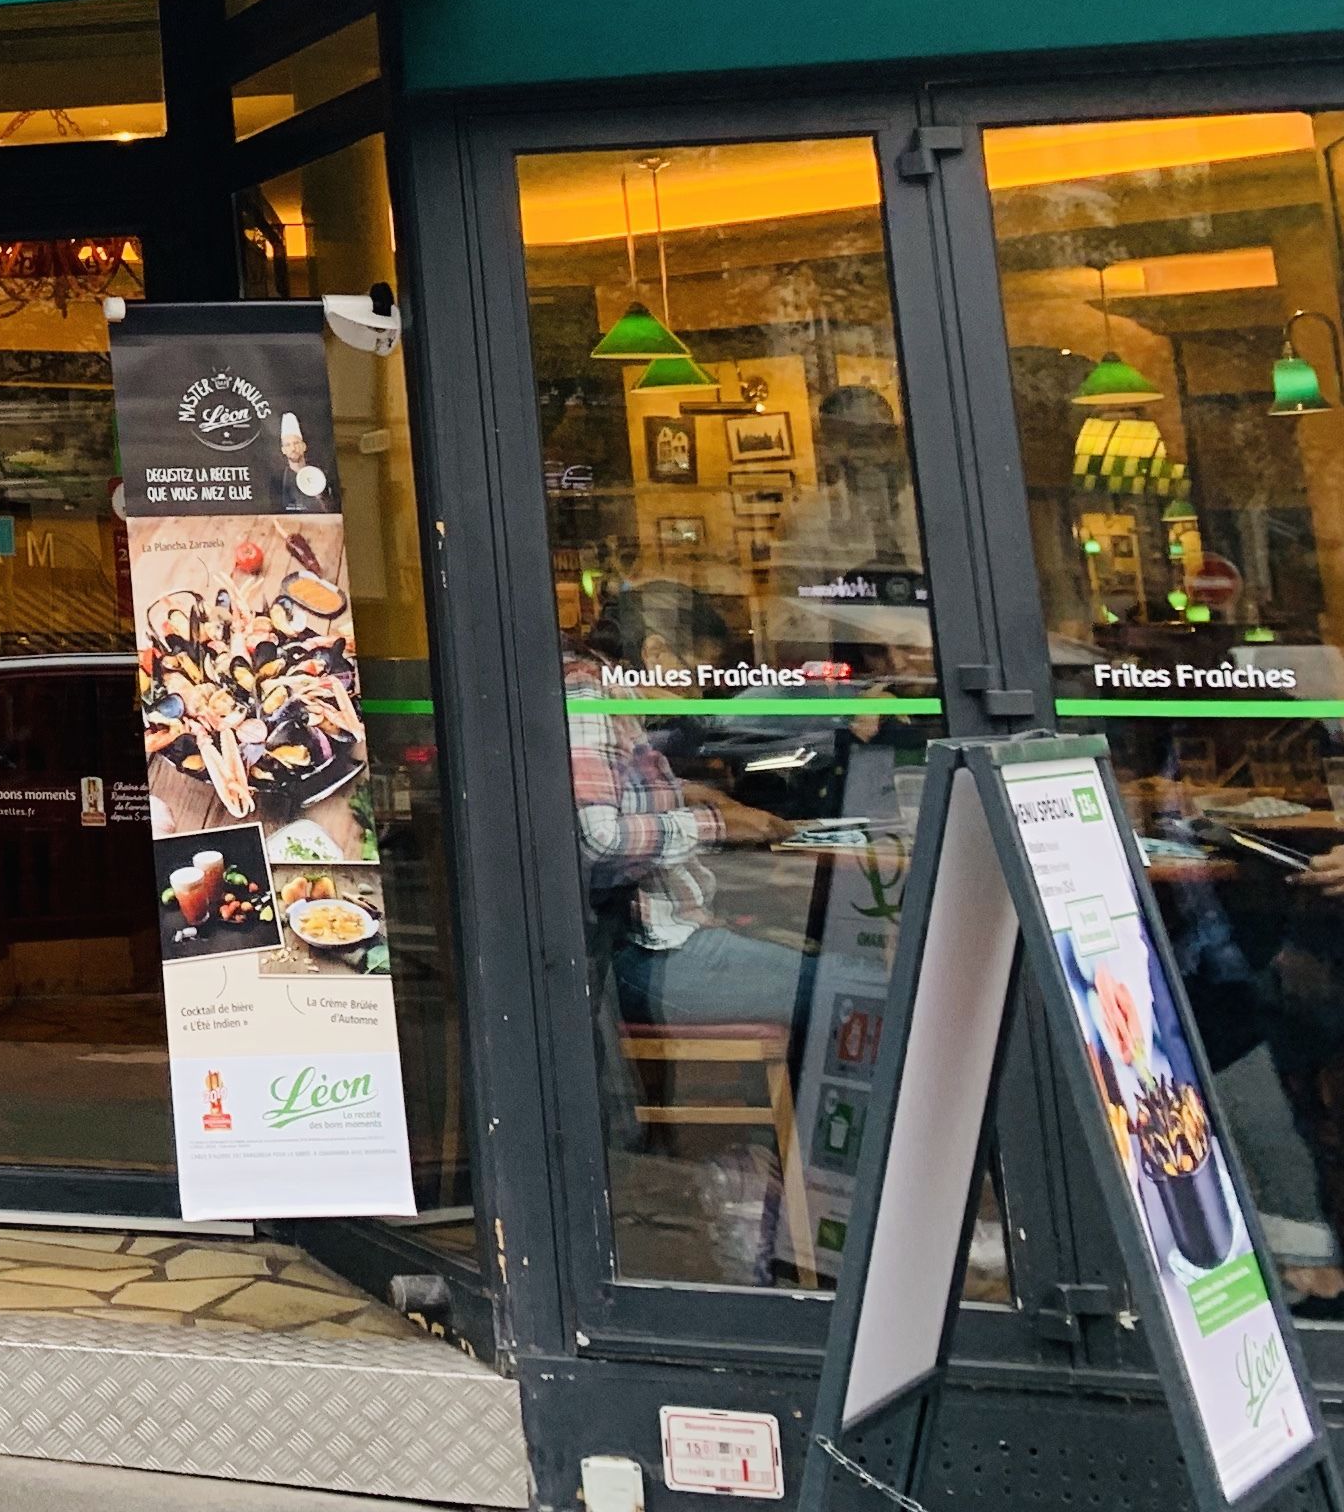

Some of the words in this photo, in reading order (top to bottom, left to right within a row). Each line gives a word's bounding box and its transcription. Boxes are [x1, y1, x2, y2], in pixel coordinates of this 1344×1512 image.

[178, 377, 214, 422] MASTER
[231, 376, 272, 419] MOULES
[198, 404, 252, 433] Léon
[146, 468, 193, 483] DEGUSTEZ
[196, 468, 209, 482] LA
[210, 466, 250, 482] RECETTE
[147, 487, 168, 503] QUE
[170, 487, 198, 501] VOUS
[201, 487, 225, 501] AVEZ
[228, 485, 253, 500] ELUE
[142, 544, 152, 553] La
[154, 540, 187, 552] Plancha
[601, 664, 692, 688] Moules
[696, 662, 807, 689] Fraîches
[1094, 663, 1171, 688] Frites
[1176, 662, 1296, 689] Fraîches
[25, 789, 76, 801] moments
[180, 1003, 216, 1018] Cocktail
[218, 1004, 230, 1014] de
[231, 1002, 254, 1013] bière
[306, 996, 317, 1007] La
[320, 997, 348, 1010] Crème
[213, 1018, 241, 1030] Indien
[330, 1013, 379, 1026] d'Automne
[262, 1066, 378, 1129] Léon
[343, 1110, 352, 1119] La
[354, 1110, 381, 1119] recette
[309, 1121, 322, 1130] des
[324, 1120, 344, 1129] bons
[345, 1120, 382, 1129] moments
